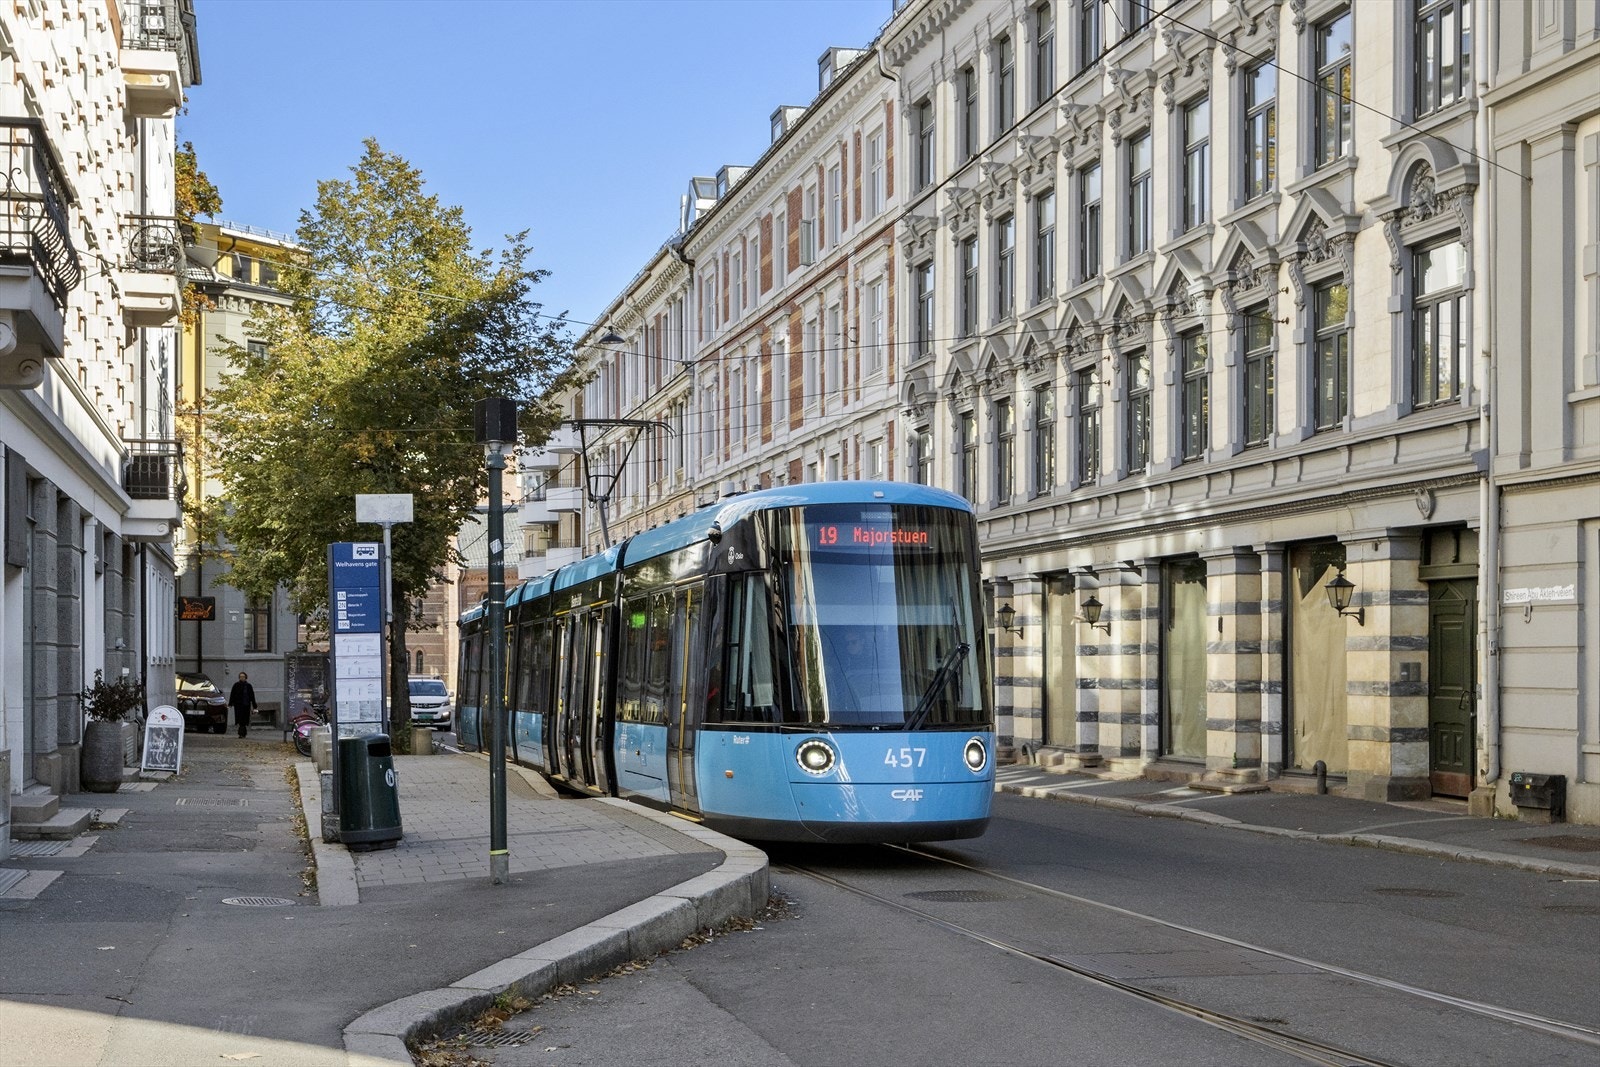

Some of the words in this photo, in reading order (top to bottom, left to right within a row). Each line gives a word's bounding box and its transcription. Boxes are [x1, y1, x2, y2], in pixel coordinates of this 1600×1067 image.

[820, 526, 838, 544] 19
[853, 527, 928, 546] Majorstuen
[1505, 591, 1528, 601] Shireen
[884, 748, 926, 768] 457
[891, 789, 924, 802] CAF
